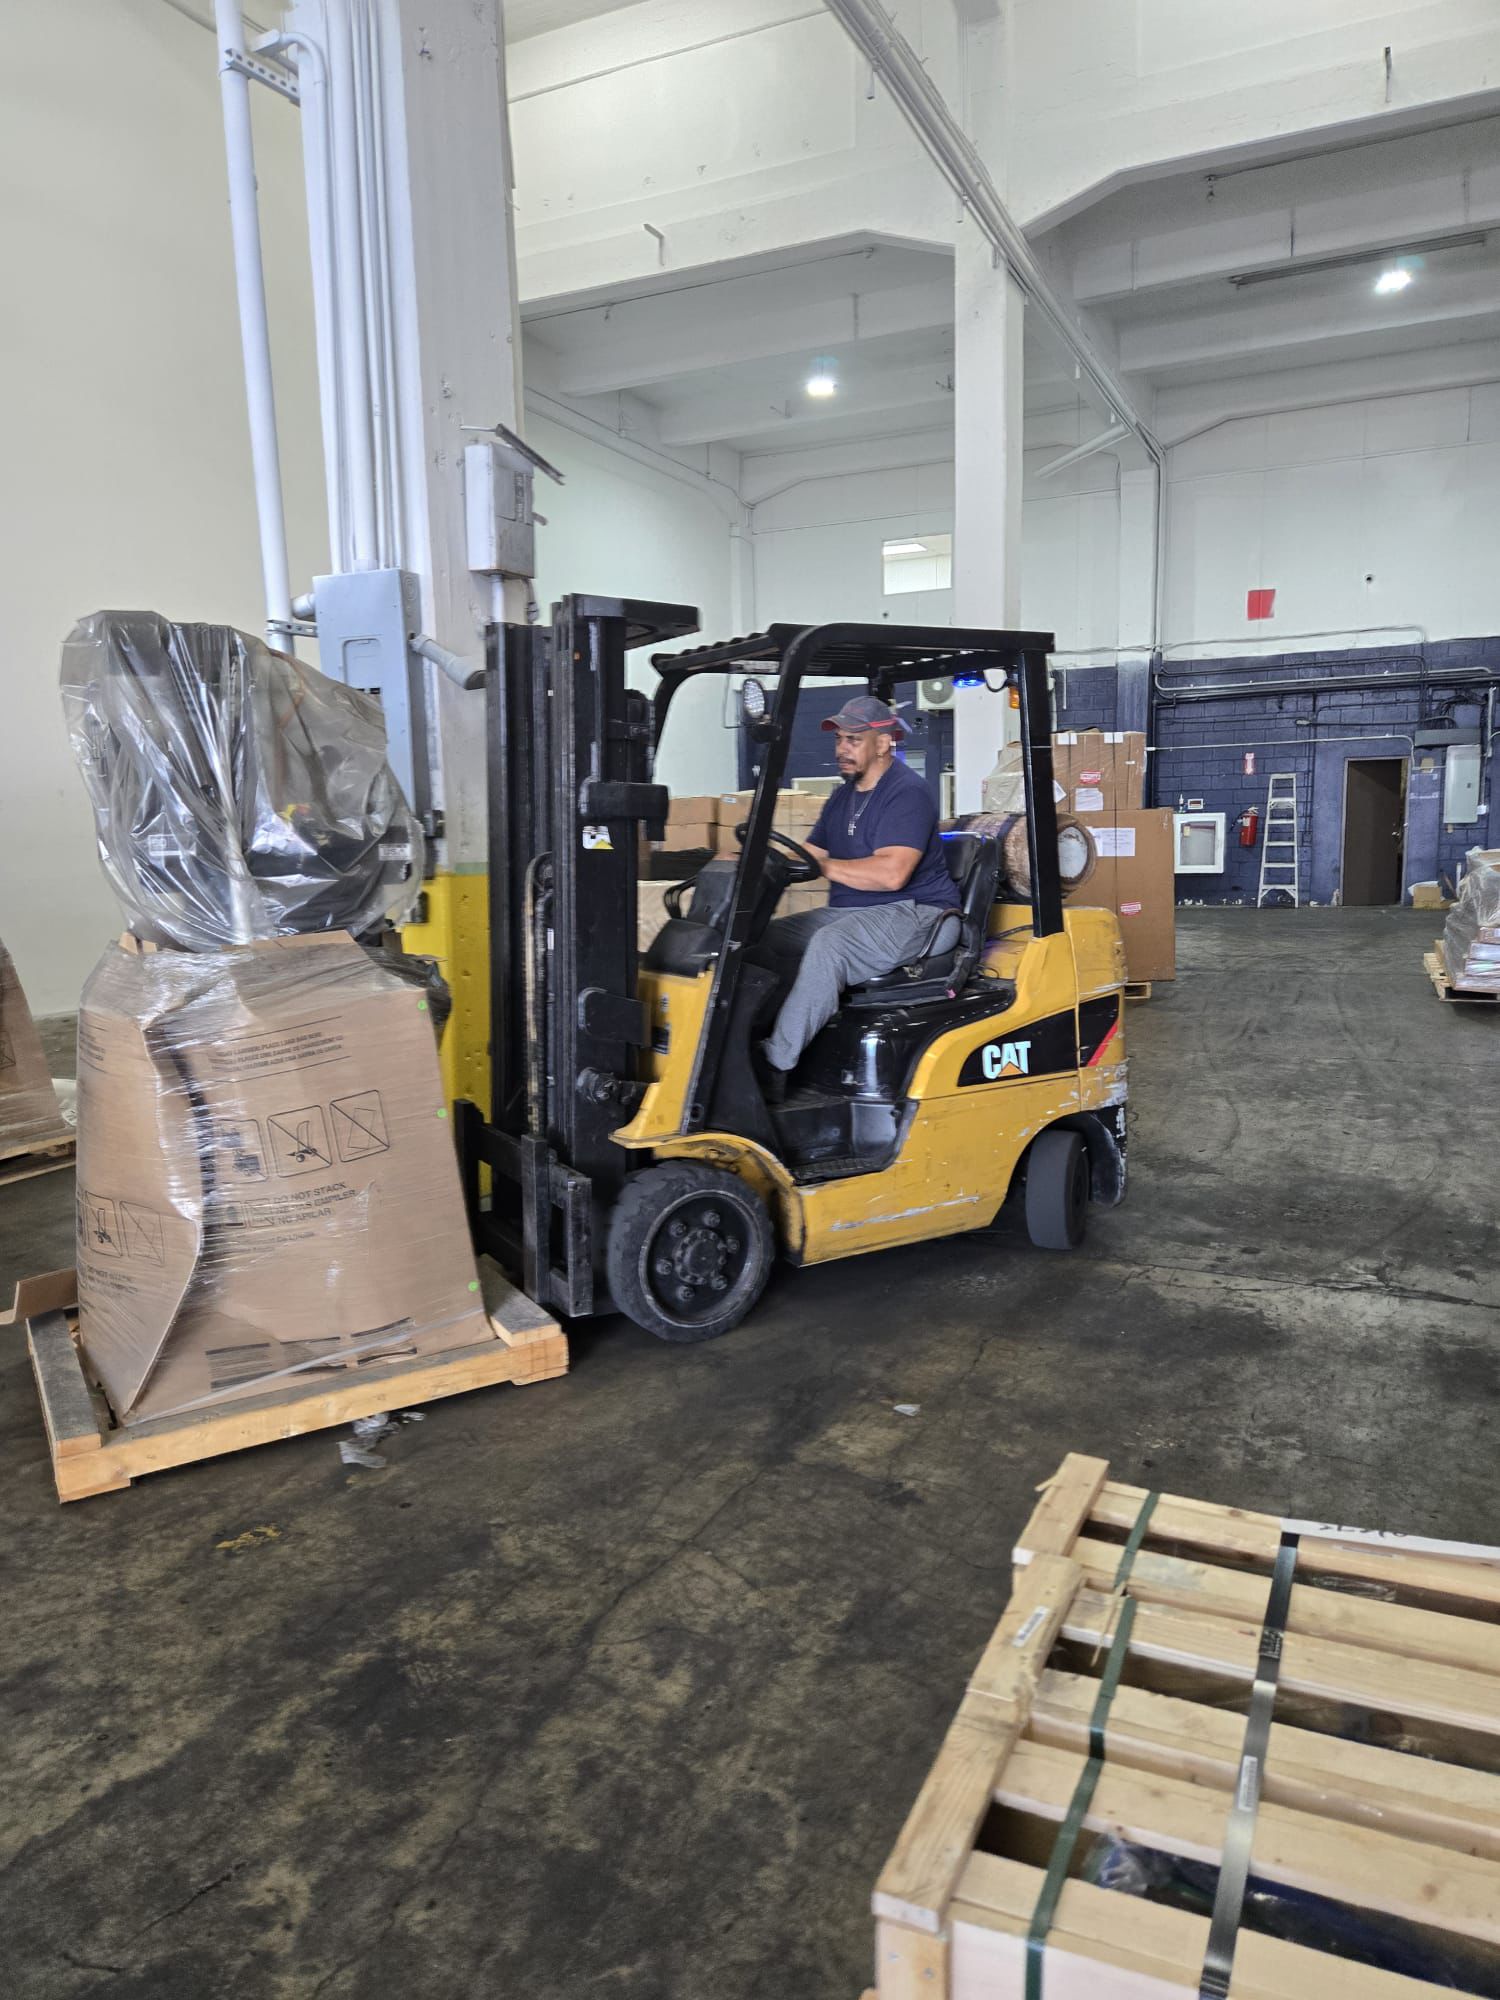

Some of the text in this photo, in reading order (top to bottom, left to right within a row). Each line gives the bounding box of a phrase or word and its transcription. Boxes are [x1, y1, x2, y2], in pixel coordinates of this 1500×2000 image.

[982, 1041, 1031, 1079] CAT
[273, 1181, 347, 1204] DO NOT STACK
